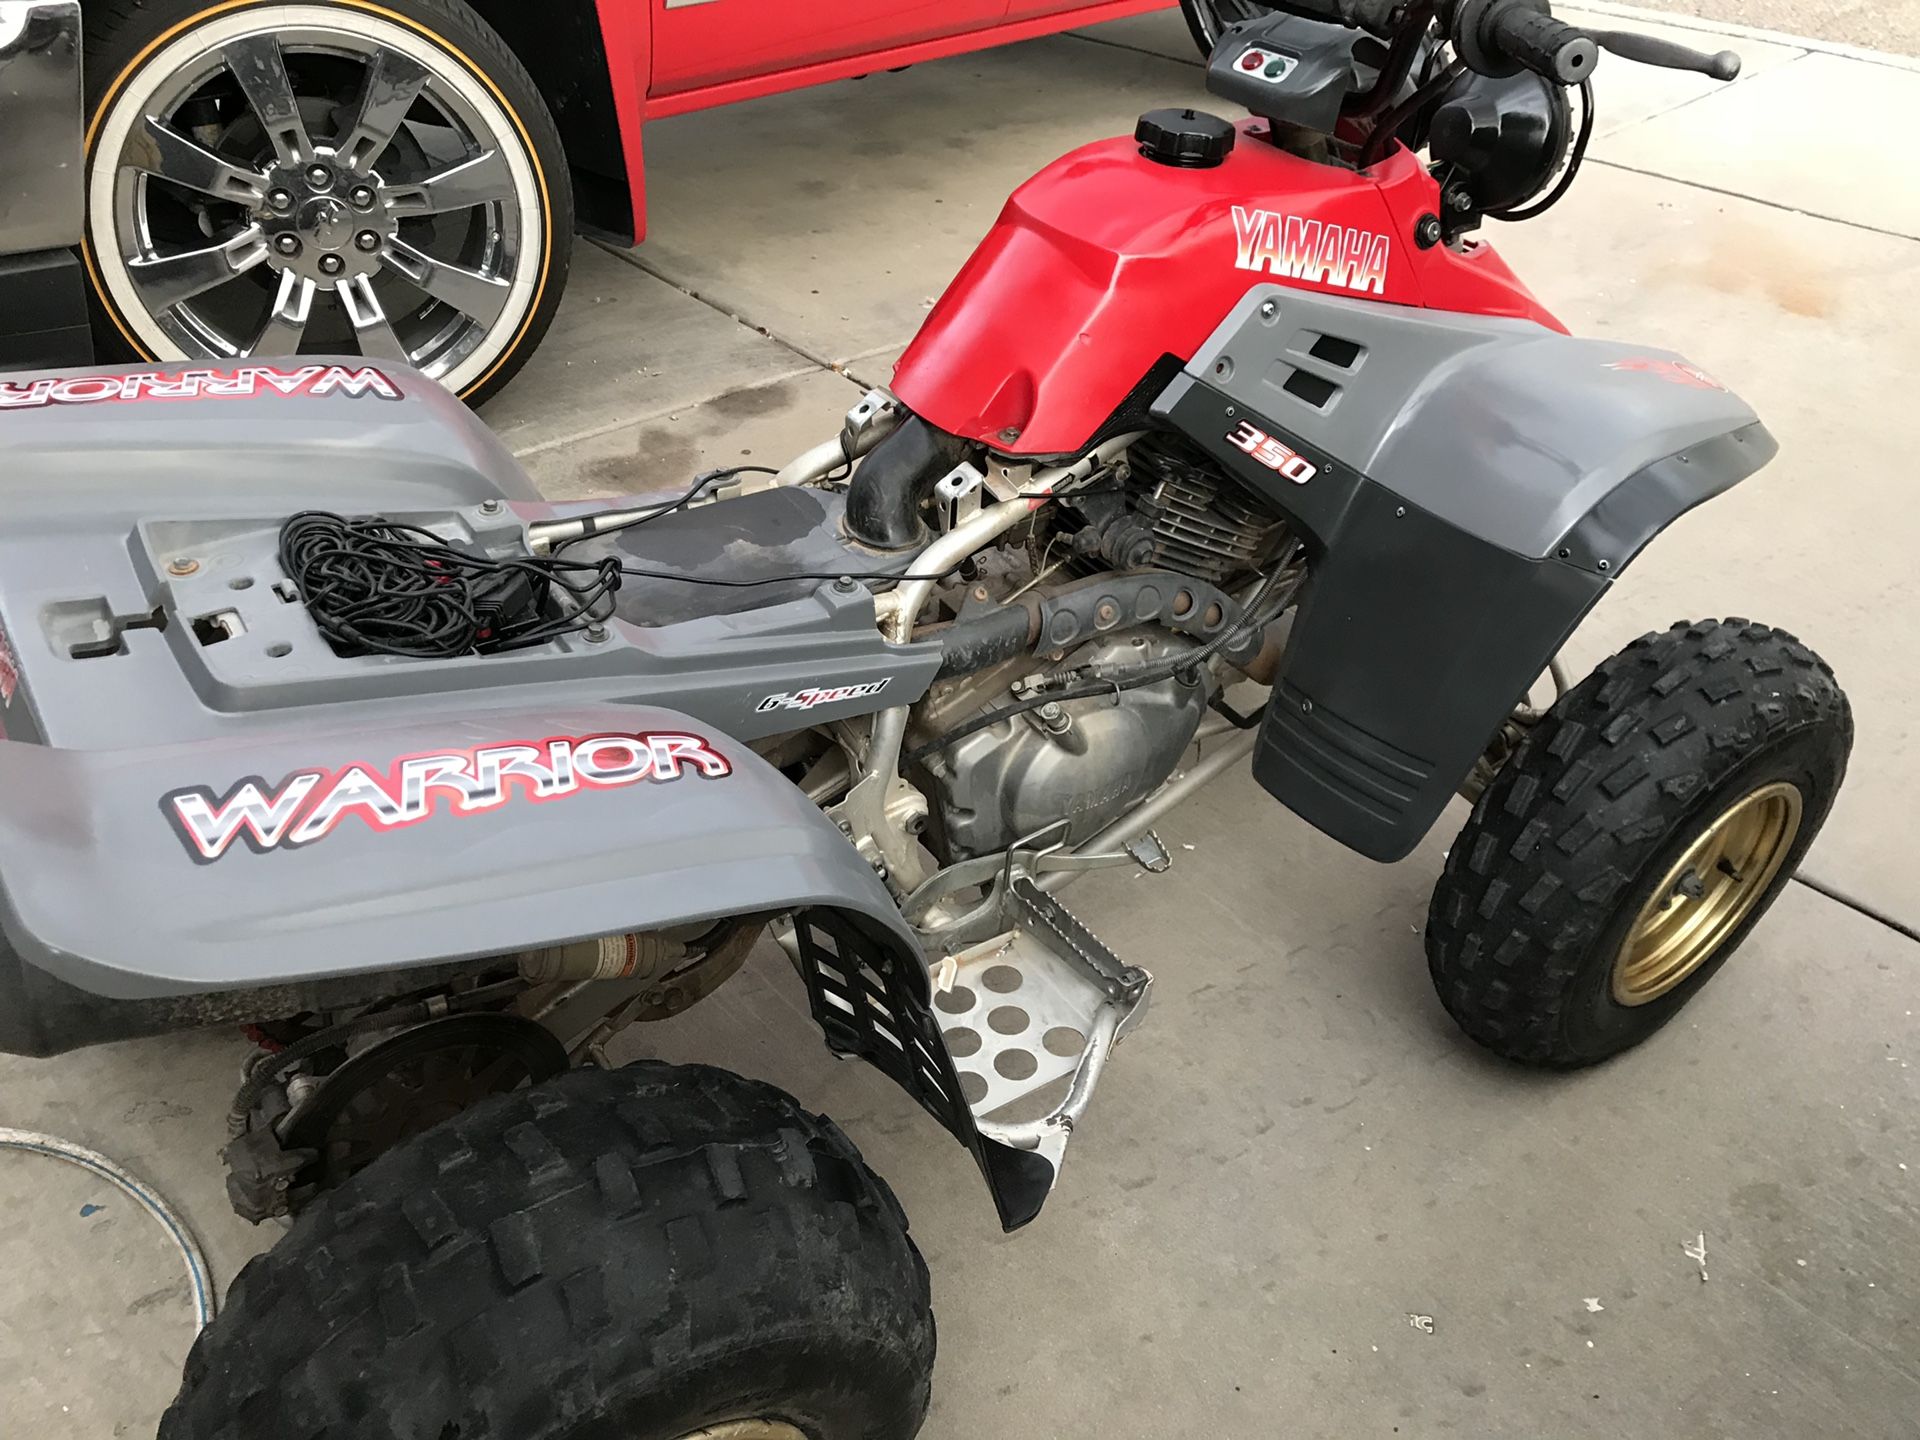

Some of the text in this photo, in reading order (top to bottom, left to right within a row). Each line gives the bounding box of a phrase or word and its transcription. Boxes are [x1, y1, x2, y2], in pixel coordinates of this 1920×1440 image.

[1231, 205, 1389, 294] YAMAHA
[0, 366, 402, 406] WARRIOR
[1225, 420, 1318, 485] 350
[756, 677, 893, 710] 6-Speed
[166, 733, 730, 863] WARRIOR
